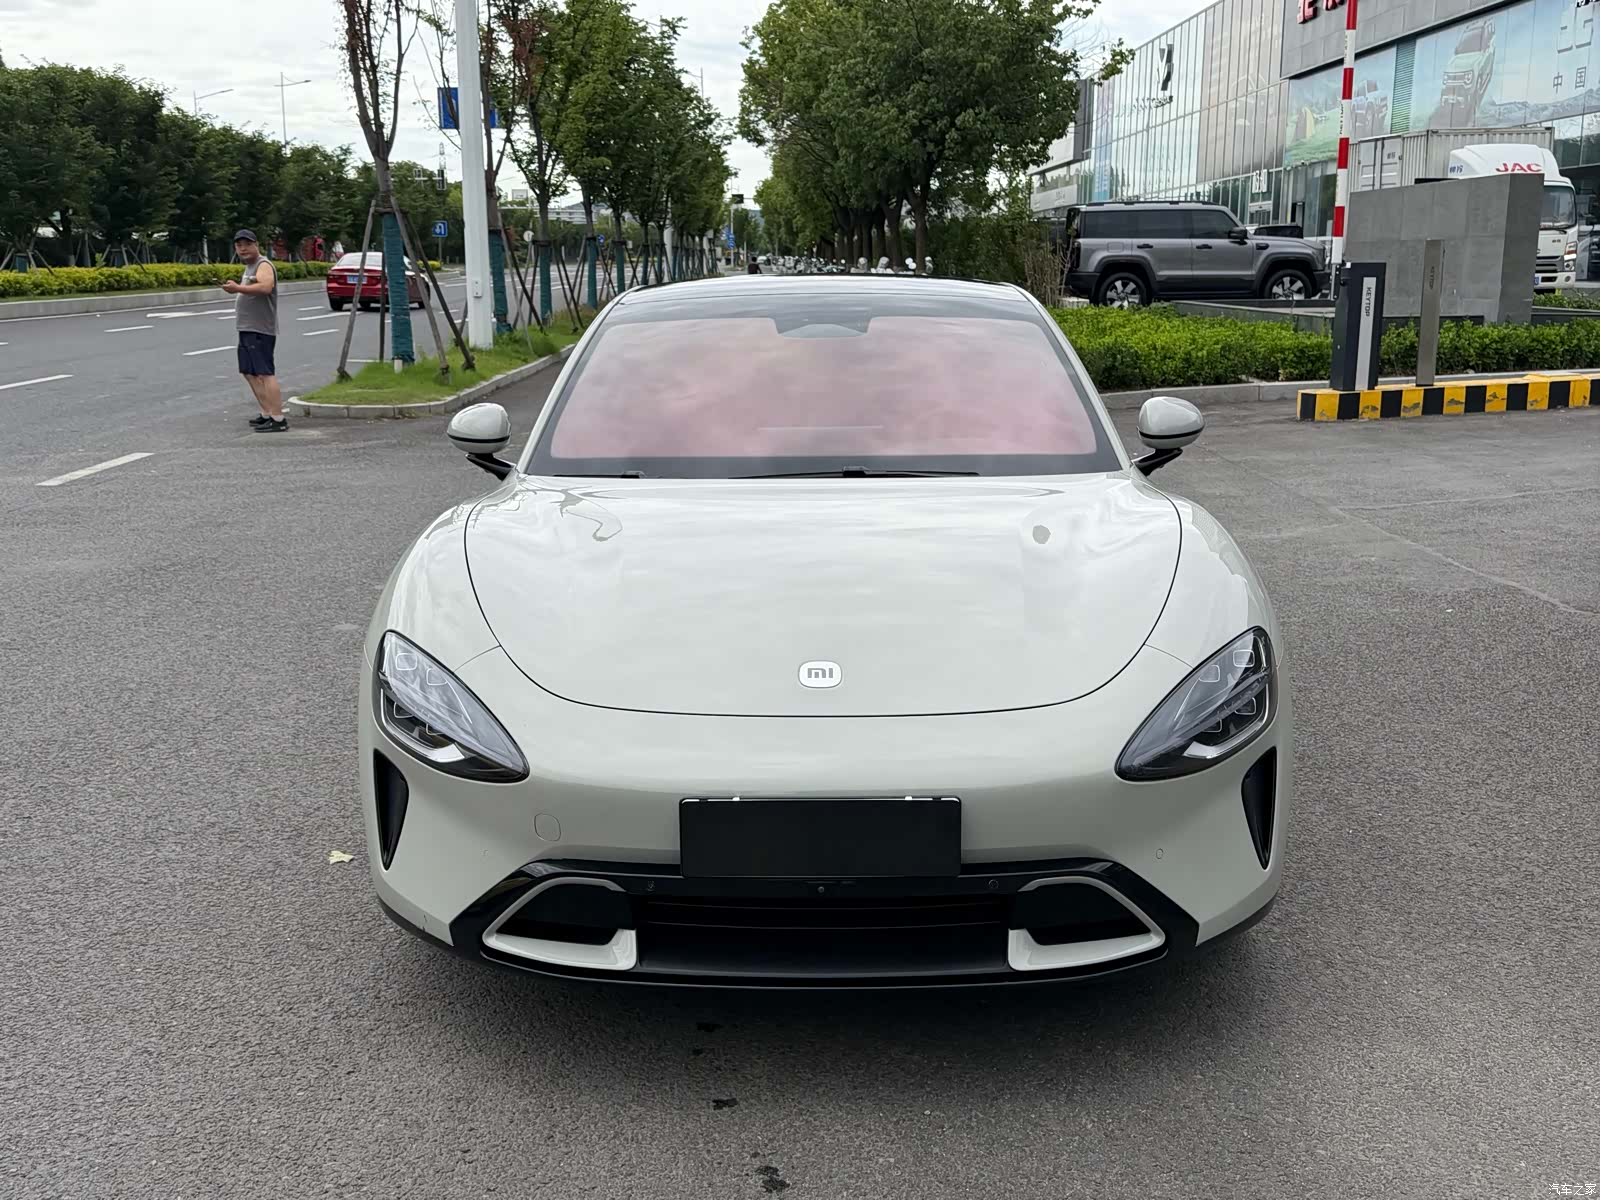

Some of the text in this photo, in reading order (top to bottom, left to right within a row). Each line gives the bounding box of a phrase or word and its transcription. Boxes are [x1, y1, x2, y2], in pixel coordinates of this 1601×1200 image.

[1553, 66, 1587, 94] 中国
[1495, 162, 1543, 173] JAC
[1364, 286, 1372, 317] KEYTOP
